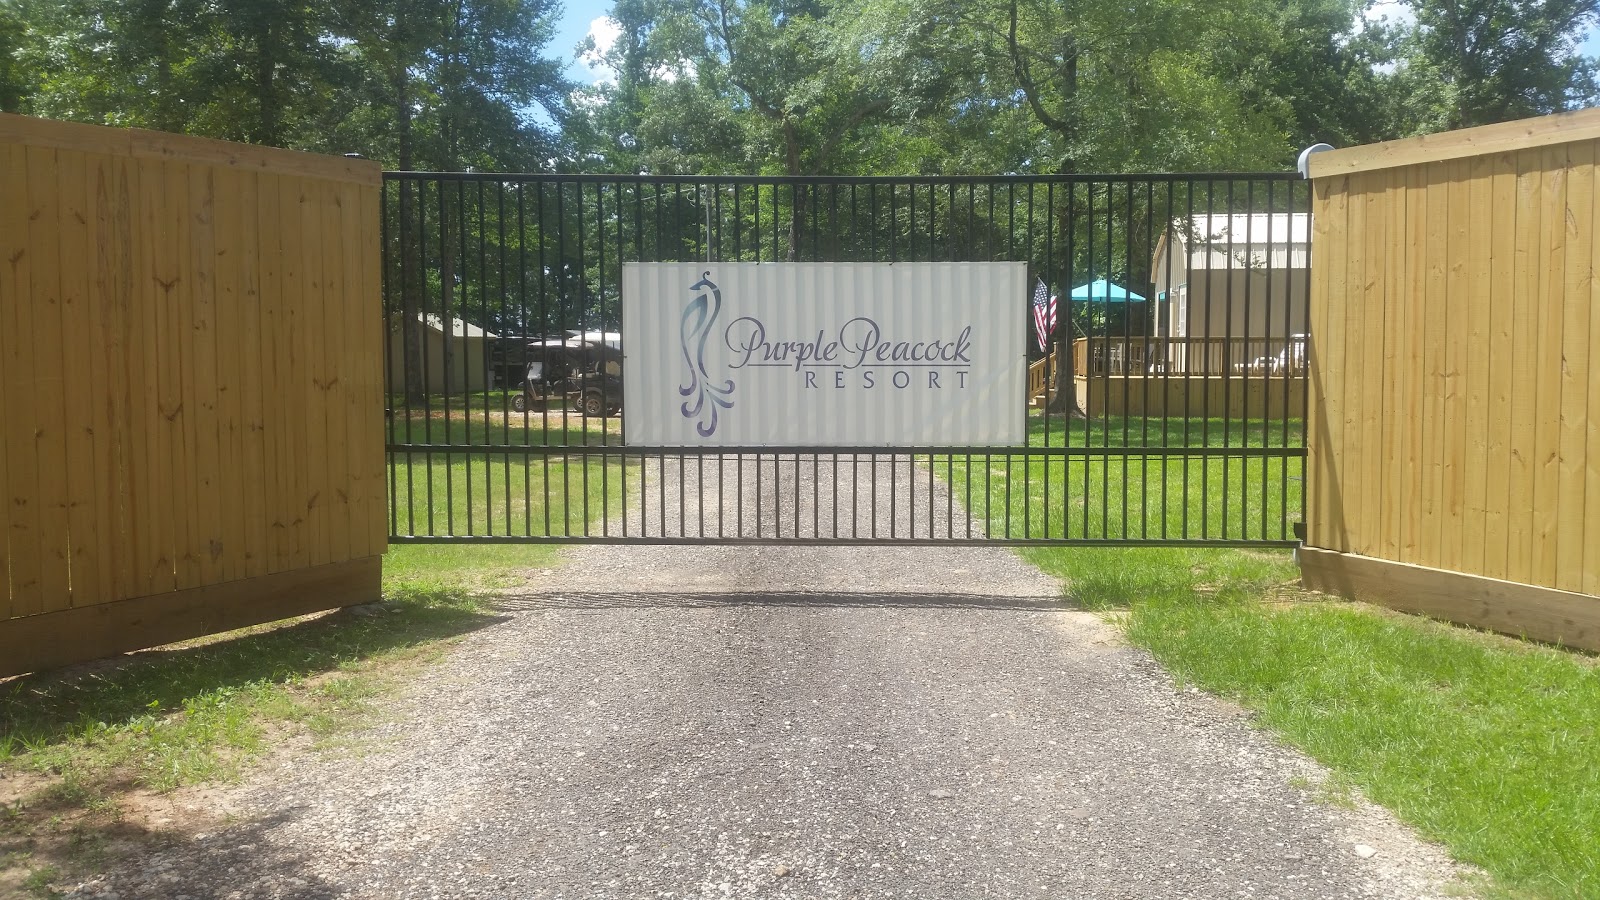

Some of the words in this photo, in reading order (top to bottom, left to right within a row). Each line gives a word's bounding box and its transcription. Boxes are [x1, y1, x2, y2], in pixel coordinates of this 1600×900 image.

[725, 316, 838, 371] Purple
[840, 316, 972, 370] Peacock
[805, 371, 969, 388] RESORT
